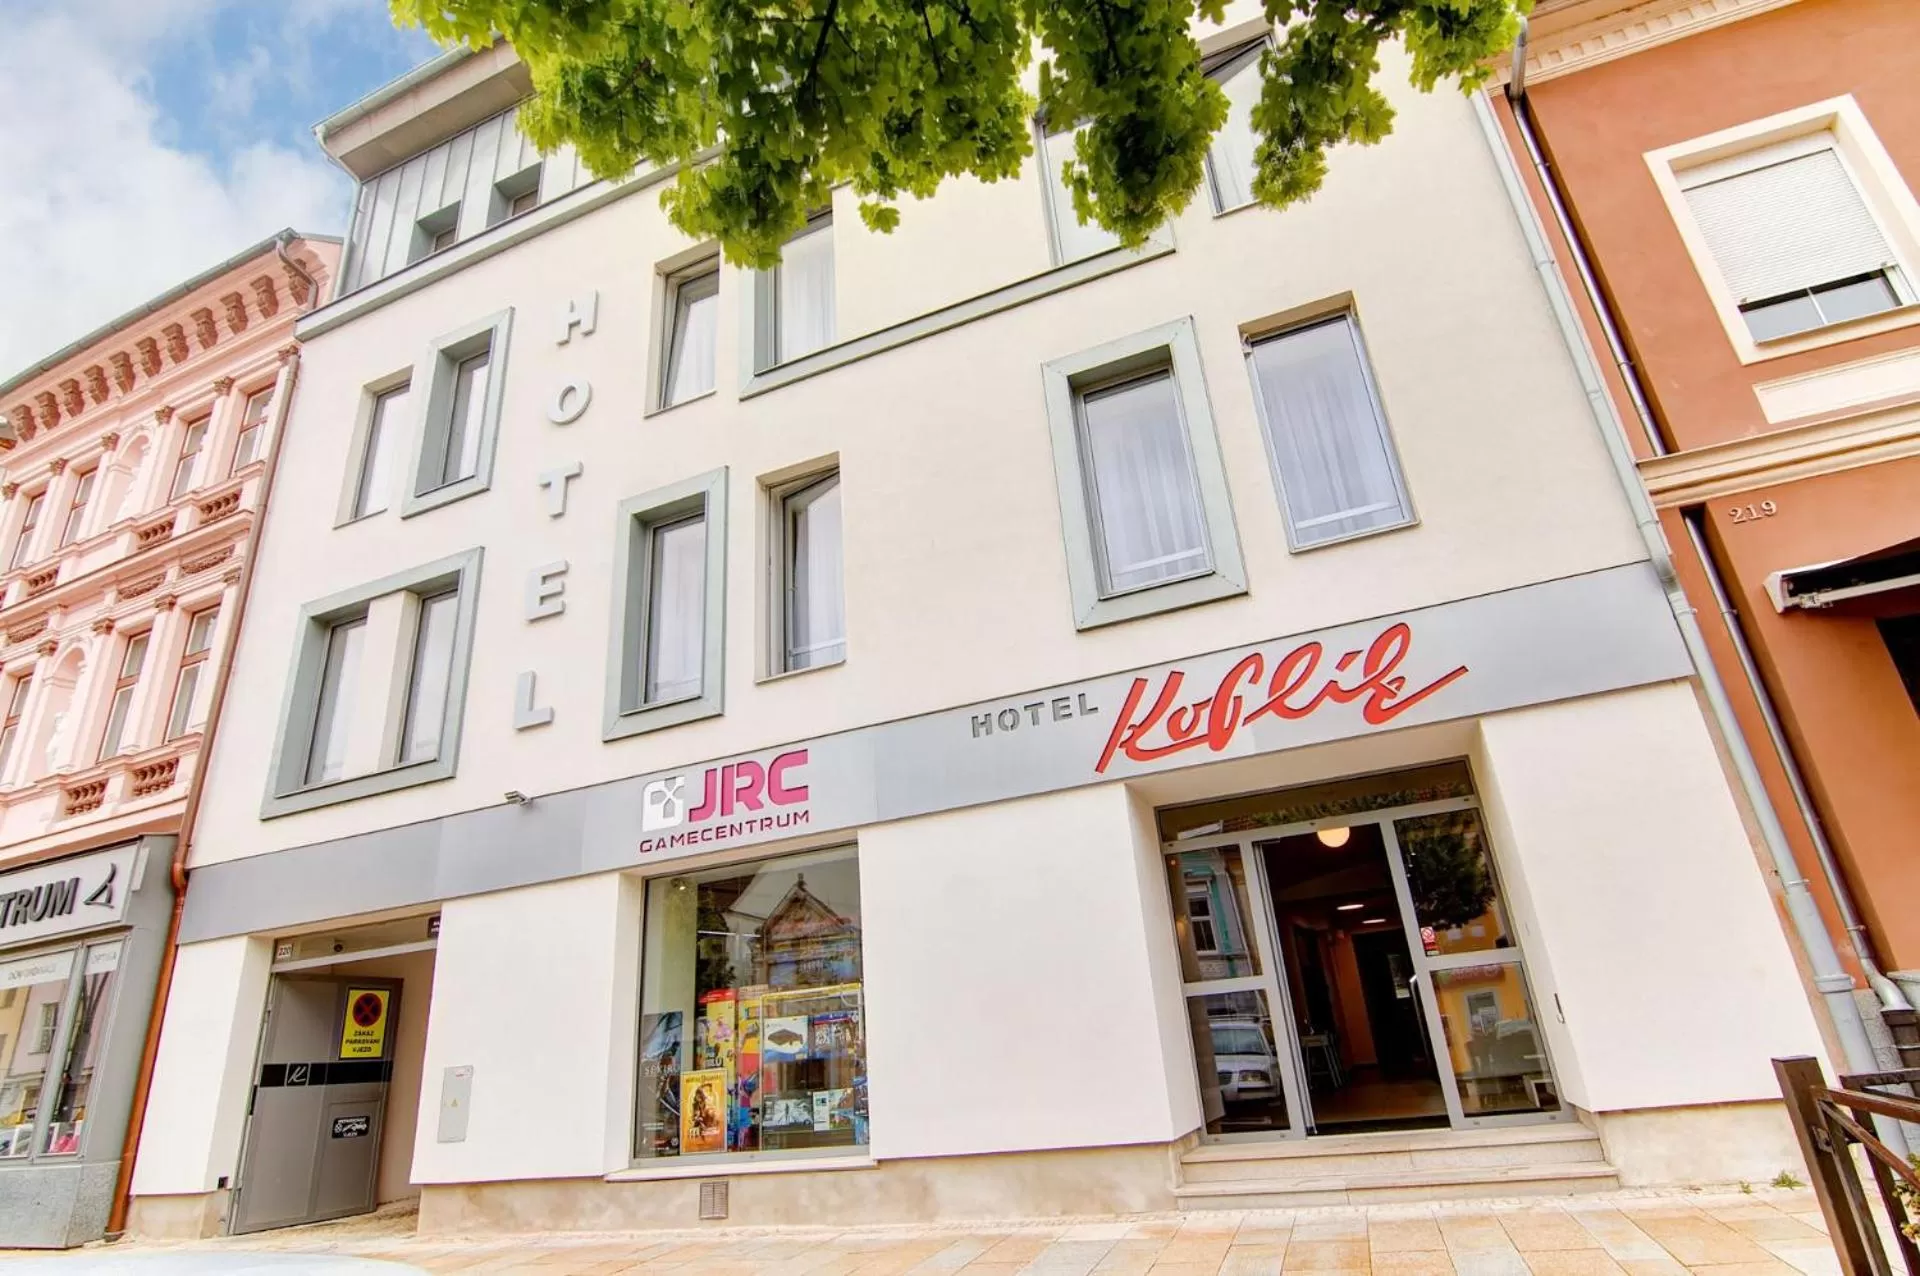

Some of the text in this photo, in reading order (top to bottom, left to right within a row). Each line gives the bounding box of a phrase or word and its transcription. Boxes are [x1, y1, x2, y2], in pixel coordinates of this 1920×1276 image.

[513, 289, 600, 731] HOTEL
[1728, 500, 1776, 524] 219
[970, 693, 1100, 738] HOTEL
[688, 748, 809, 824] JRC
[639, 809, 810, 854] GAMECENTRUM
